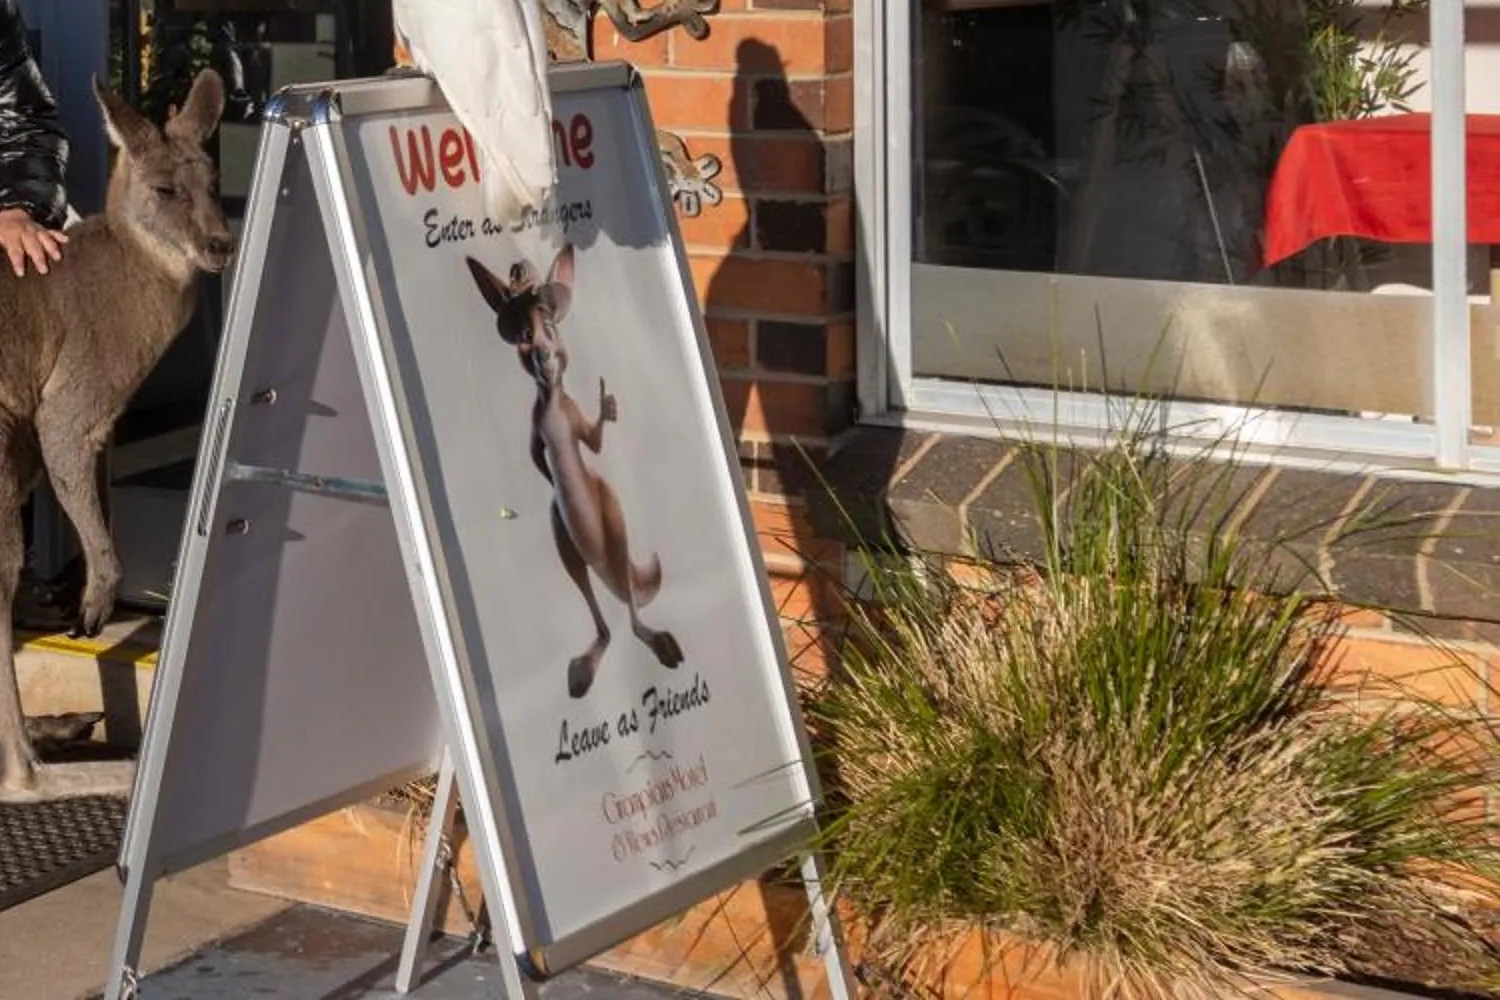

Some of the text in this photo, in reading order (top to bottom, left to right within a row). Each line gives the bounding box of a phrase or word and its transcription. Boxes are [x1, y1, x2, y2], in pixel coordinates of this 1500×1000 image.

[423, 207, 477, 249] Enter
[554, 672, 711, 764] Leave as Friends
